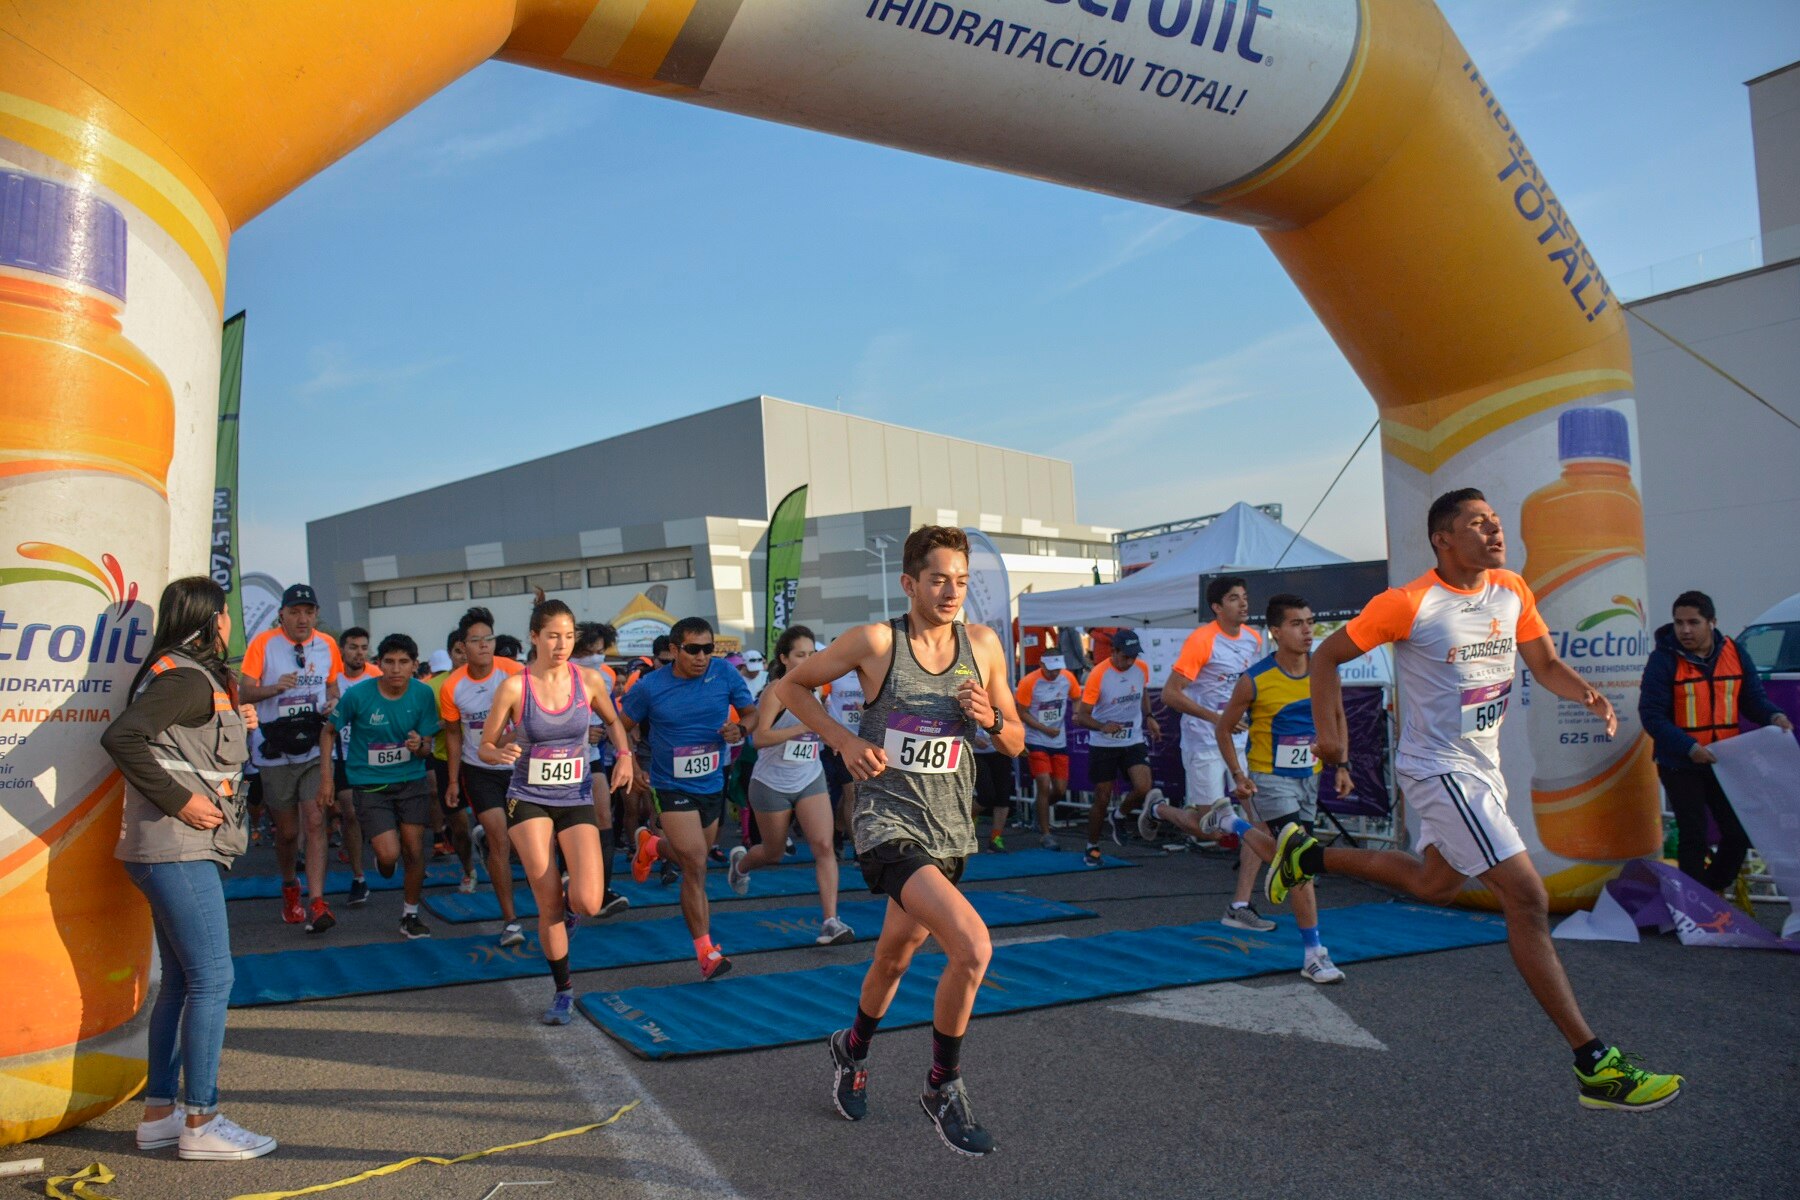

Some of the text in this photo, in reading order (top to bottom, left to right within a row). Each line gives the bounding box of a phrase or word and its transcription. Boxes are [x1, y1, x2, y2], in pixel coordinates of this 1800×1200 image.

[1140, 61, 1248, 115] TOTAL!
[1497, 147, 1608, 323] TOTAL!
[1459, 637, 1513, 661] CARRERA
[1549, 629, 1650, 658] lectrolit
[2, 708, 111, 723] ANDARINA
[1476, 701, 1503, 732] 597
[1560, 732, 1589, 744] 625
[378, 750, 402, 764] 654
[792, 743, 813, 759] 442
[900, 737, 947, 769] 548
[1290, 748, 1307, 765] 24
[541, 762, 572, 781] 549
[684, 756, 710, 774] 439
